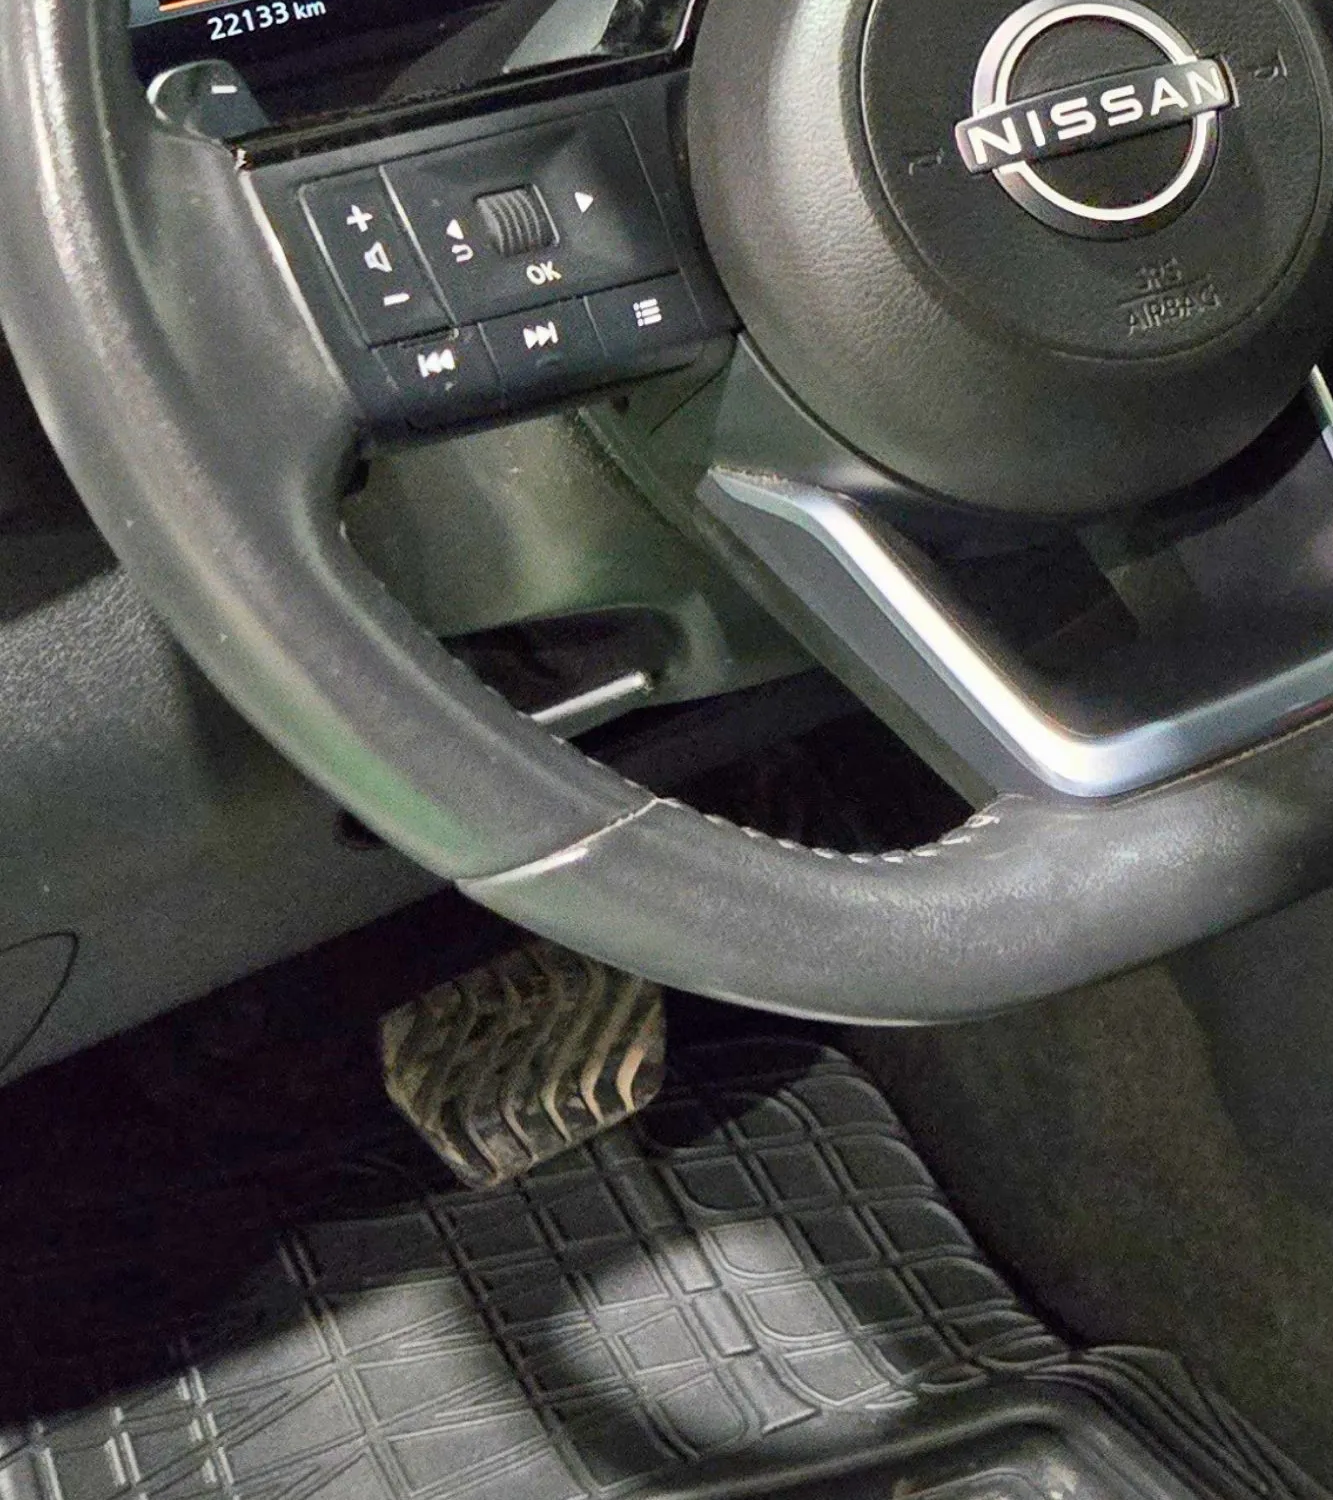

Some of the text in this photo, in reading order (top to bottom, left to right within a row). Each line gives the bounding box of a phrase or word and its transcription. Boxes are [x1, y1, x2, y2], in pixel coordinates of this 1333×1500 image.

[207, 0, 290, 41] 22133
[966, 66, 1227, 165] NISSAN
[526, 260, 562, 287] OK
